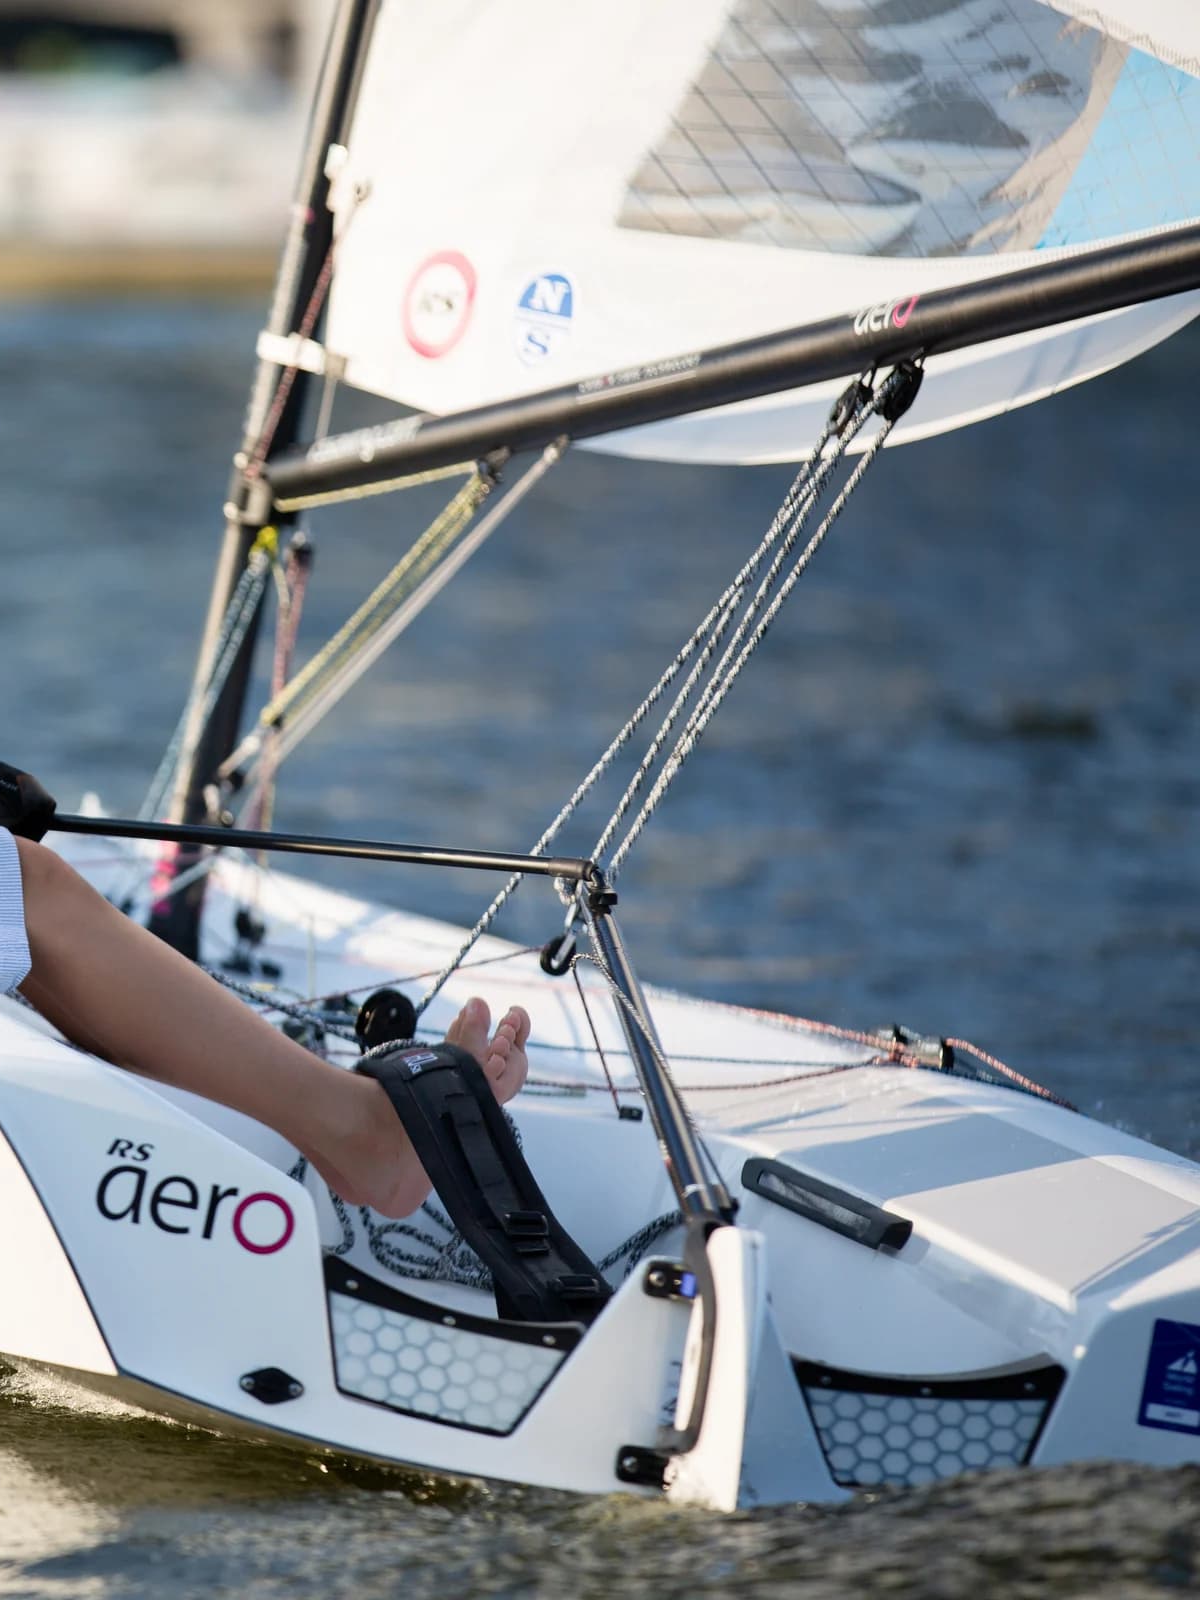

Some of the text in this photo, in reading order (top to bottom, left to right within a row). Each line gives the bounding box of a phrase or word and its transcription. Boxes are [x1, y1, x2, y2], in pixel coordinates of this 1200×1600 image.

[528, 275, 569, 315] N
[107, 1138, 155, 1162] RS
[96, 1164, 295, 1255] aero
